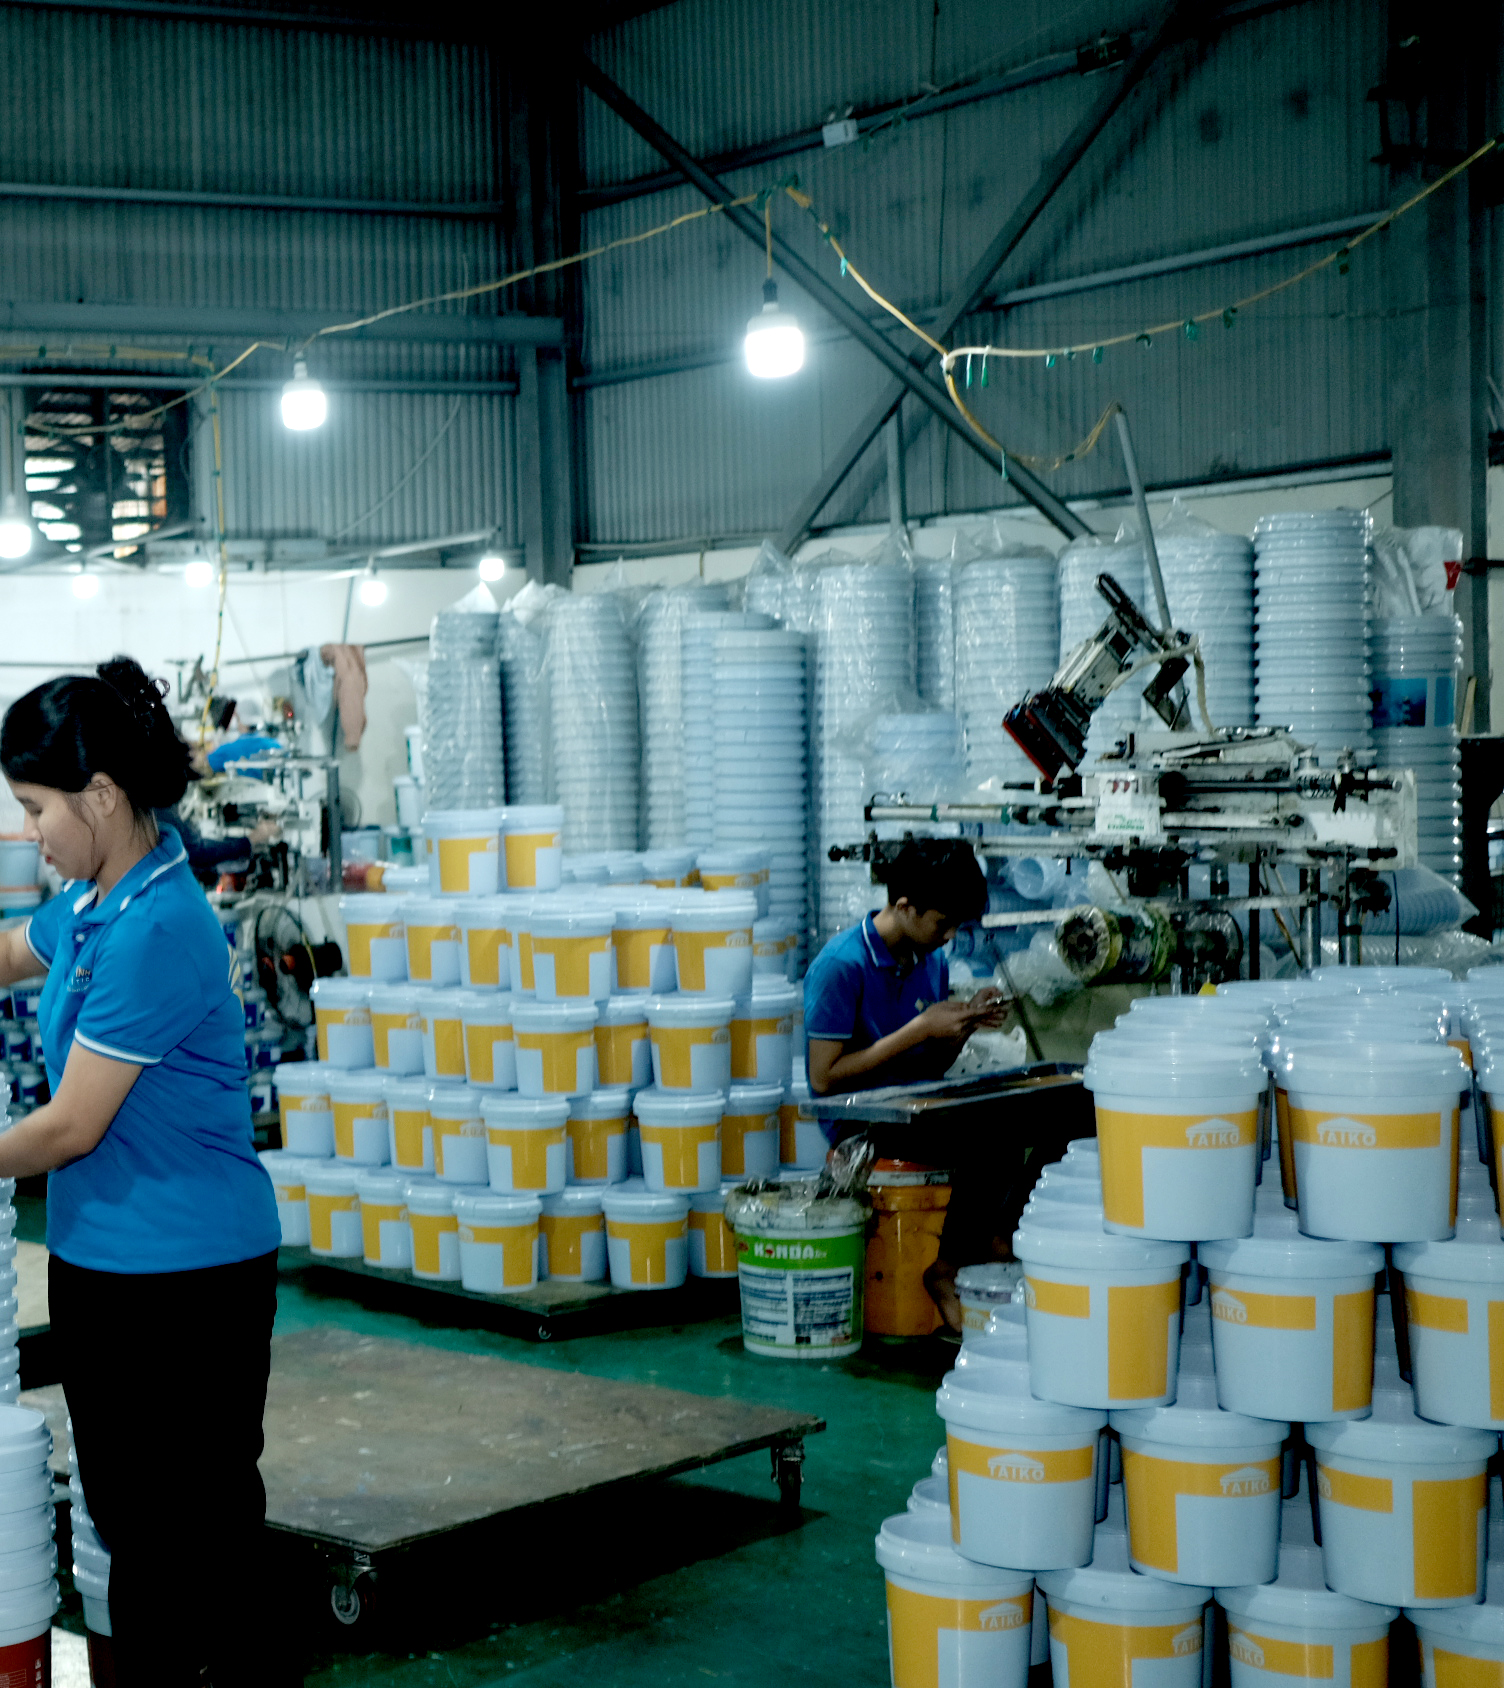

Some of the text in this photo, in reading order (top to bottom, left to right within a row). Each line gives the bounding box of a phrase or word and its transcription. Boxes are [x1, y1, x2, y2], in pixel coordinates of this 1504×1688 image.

[1187, 1130, 1240, 1147] TAIKO
[1317, 1129, 1377, 1147] TAIKO
[1210, 1302, 1248, 1323] AIKO
[988, 1464, 1045, 1482] TAIKO
[1220, 1477, 1271, 1496] TAIKO
[979, 1611, 1024, 1630] TAIKO
